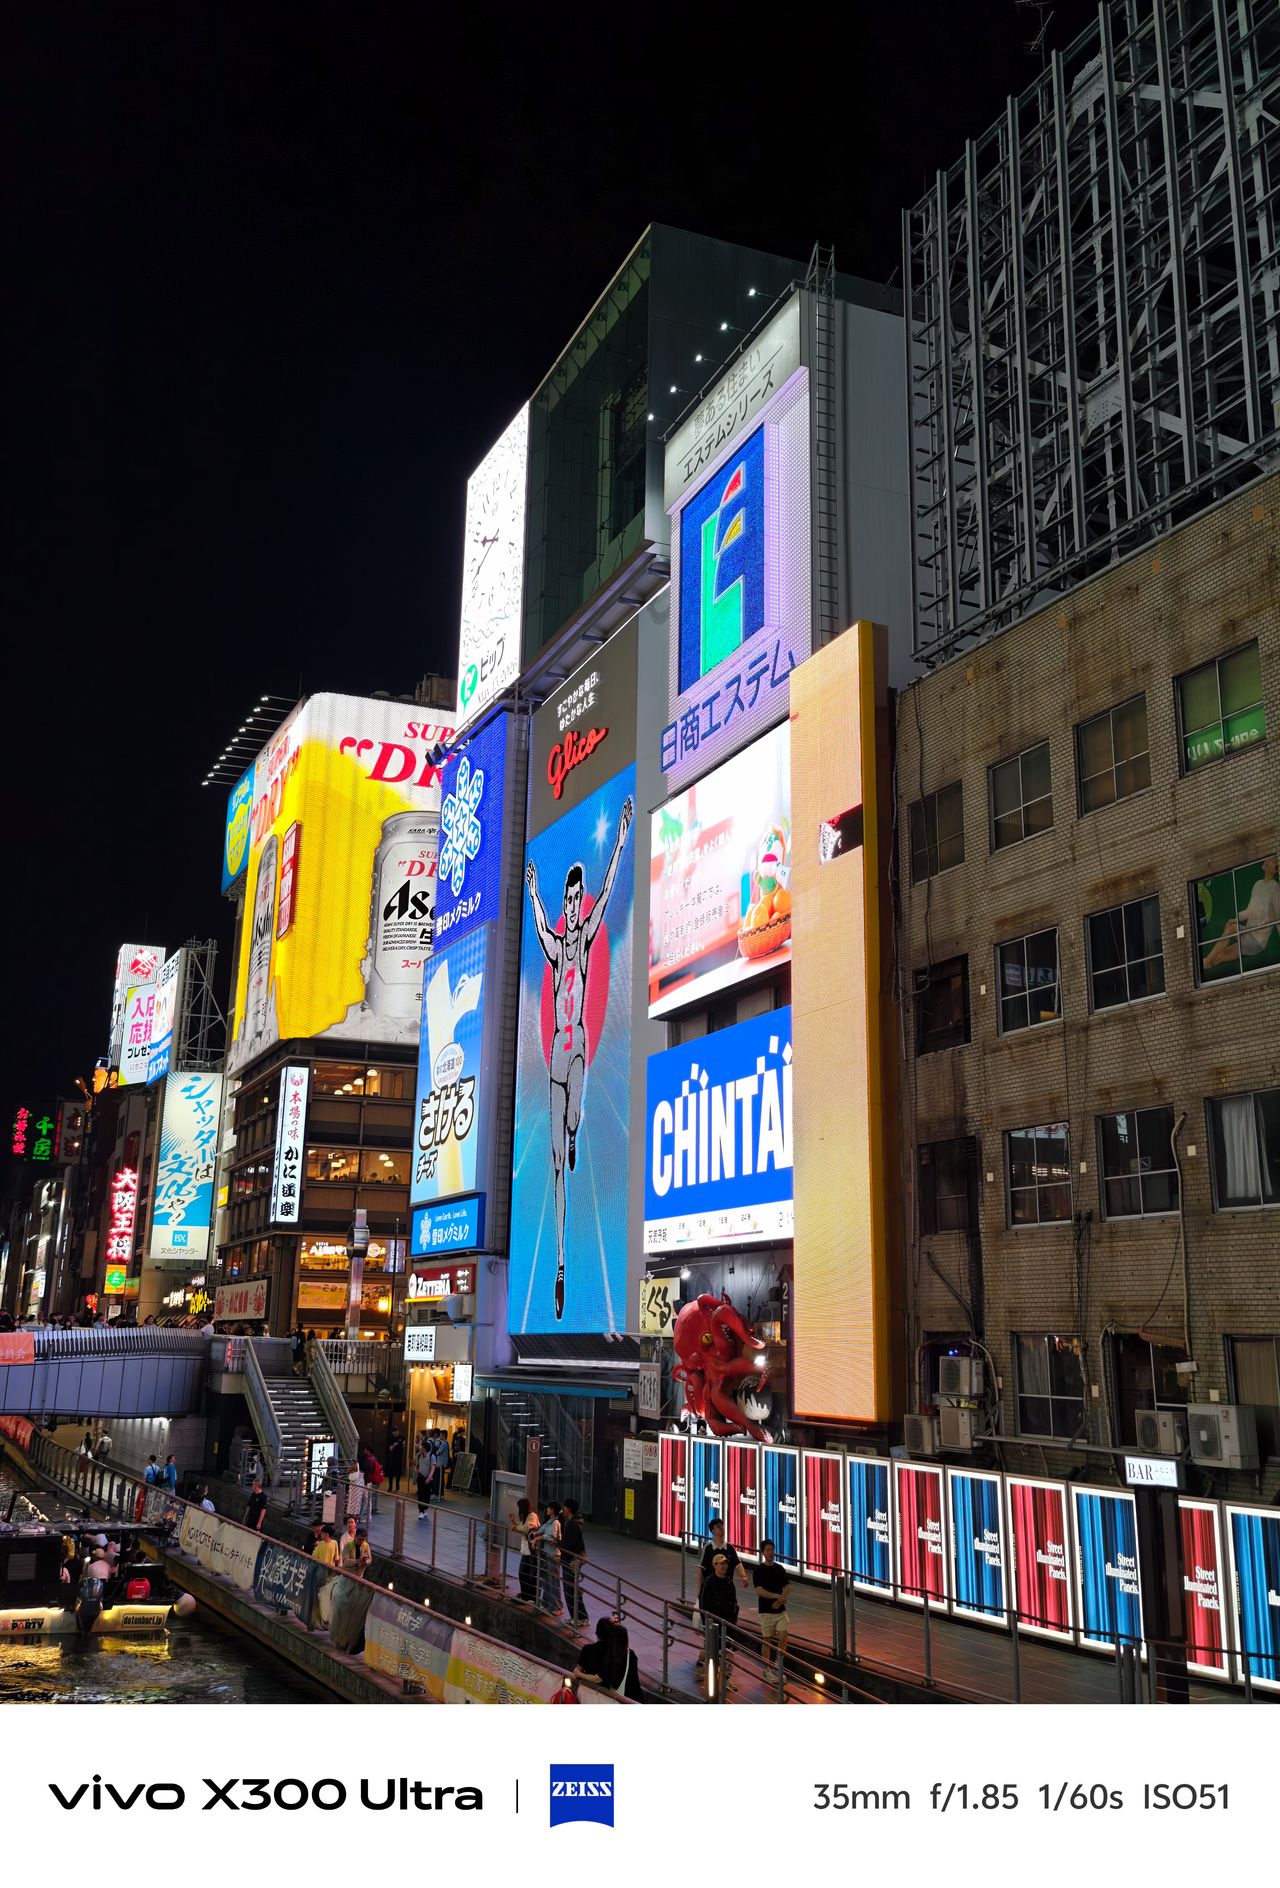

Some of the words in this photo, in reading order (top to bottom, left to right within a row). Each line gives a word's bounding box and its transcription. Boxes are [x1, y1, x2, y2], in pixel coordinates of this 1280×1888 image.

[683, 363, 775, 484] エステムシリーズ
[557, 671, 599, 717] すこやかな毎日、
[558, 691, 597, 732] ゆたかな人生
[660, 639, 796, 773] 日商エステム
[547, 727, 608, 800] Glico
[435, 891, 482, 937] 雪印メグミルク
[563, 961, 576, 1052] グリコ
[287, 1090, 302, 1141] 本場の味
[418, 1075, 476, 1151] さける
[34, 1115, 54, 1155] 千房
[416, 1149, 438, 1184] チーズ
[107, 1167, 138, 1262] 大阪王将
[174, 1233, 186, 1243] BX
[431, 1222, 470, 1246] 雪印メグミルク
[781, 1282, 789, 1322] 2F
[1128, 1462, 1154, 1481] BAR
[874, 1509, 887, 1521] Street
[926, 1518, 940, 1531] Street
[918, 1526, 941, 1542] Illuminated
[984, 1528, 998, 1542] Street
[974, 1537, 1000, 1554] Illuminated
[1047, 1540, 1062, 1554] Street
[985, 1552, 1002, 1567] Panels.
[1036, 1550, 1064, 1566] Illuminated
[1118, 1552, 1135, 1567] Street
[1049, 1566, 1067, 1580] Panels.
[1106, 1562, 1137, 1580] Illuminated
[1195, 1565, 1214, 1581] Street
[1119, 1579, 1140, 1594] Panels.
[1184, 1576, 1217, 1596] Illuminated
[1198, 1594, 1220, 1610] Panels.
[11, 1621, 44, 1630] PARTY
